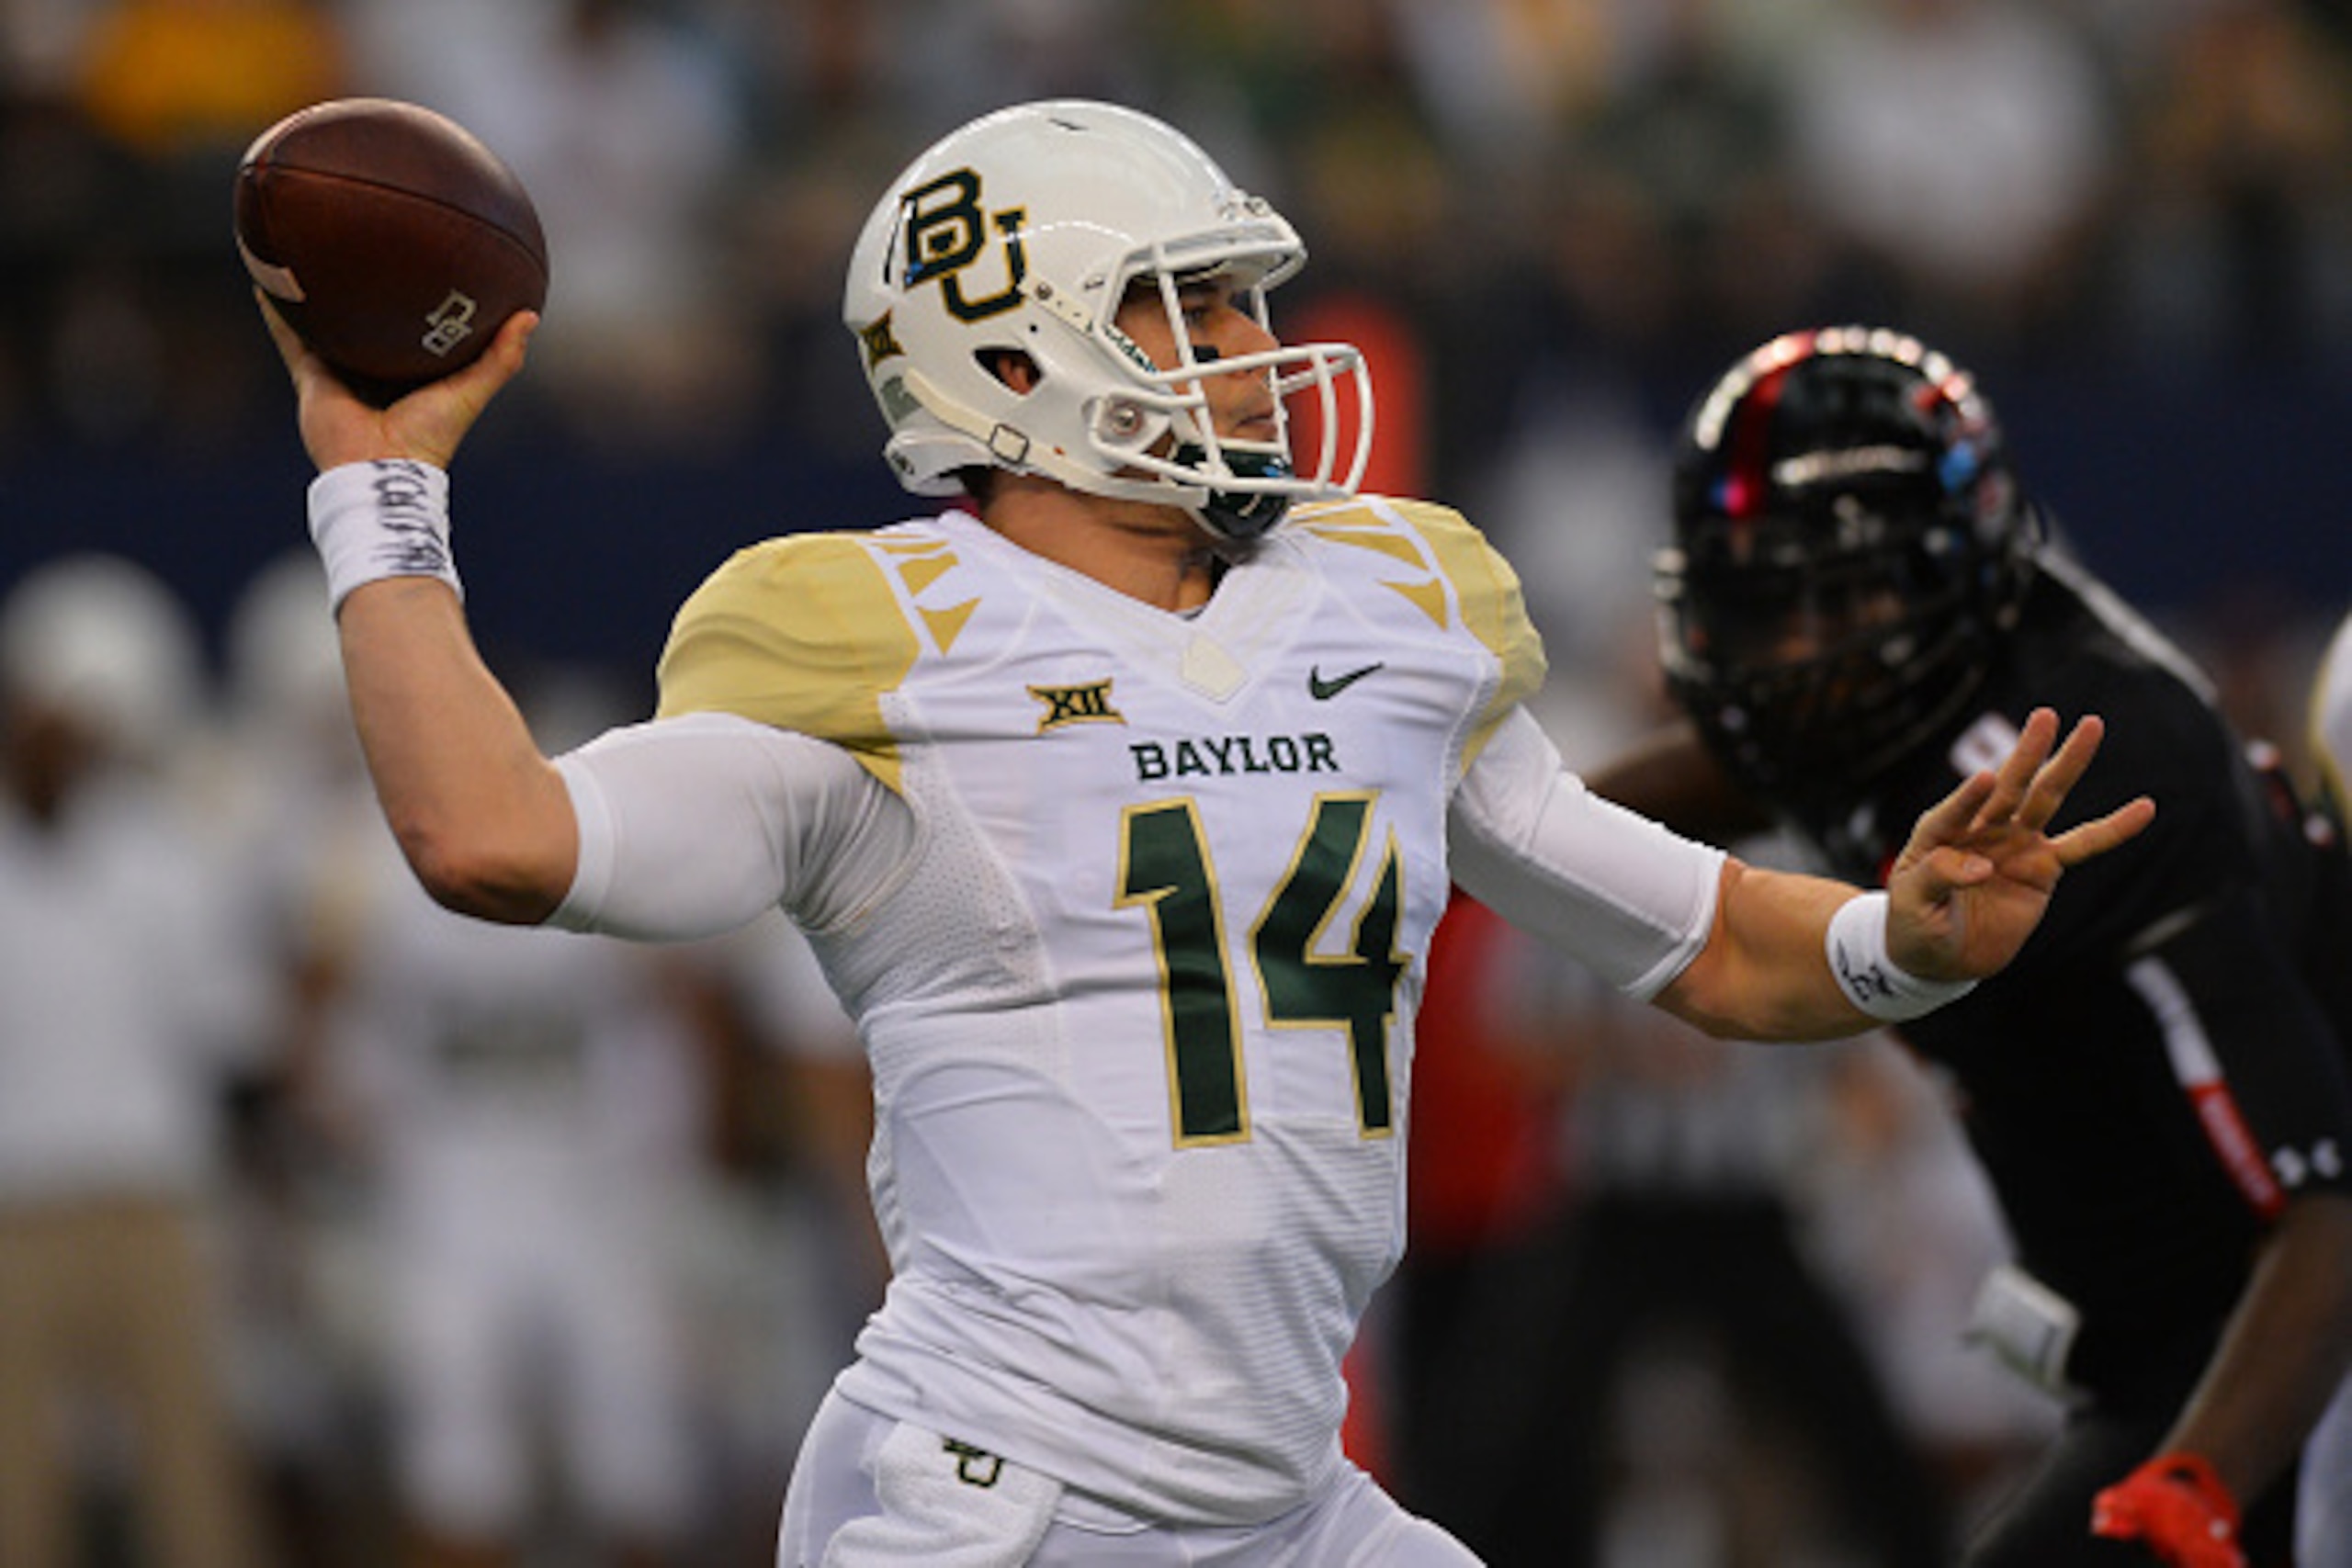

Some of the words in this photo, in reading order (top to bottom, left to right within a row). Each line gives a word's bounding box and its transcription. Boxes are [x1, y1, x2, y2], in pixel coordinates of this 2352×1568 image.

[899, 165, 1028, 324] BU
[1129, 732, 1340, 781] BAYLOR
[1112, 790, 1415, 1150] 14
